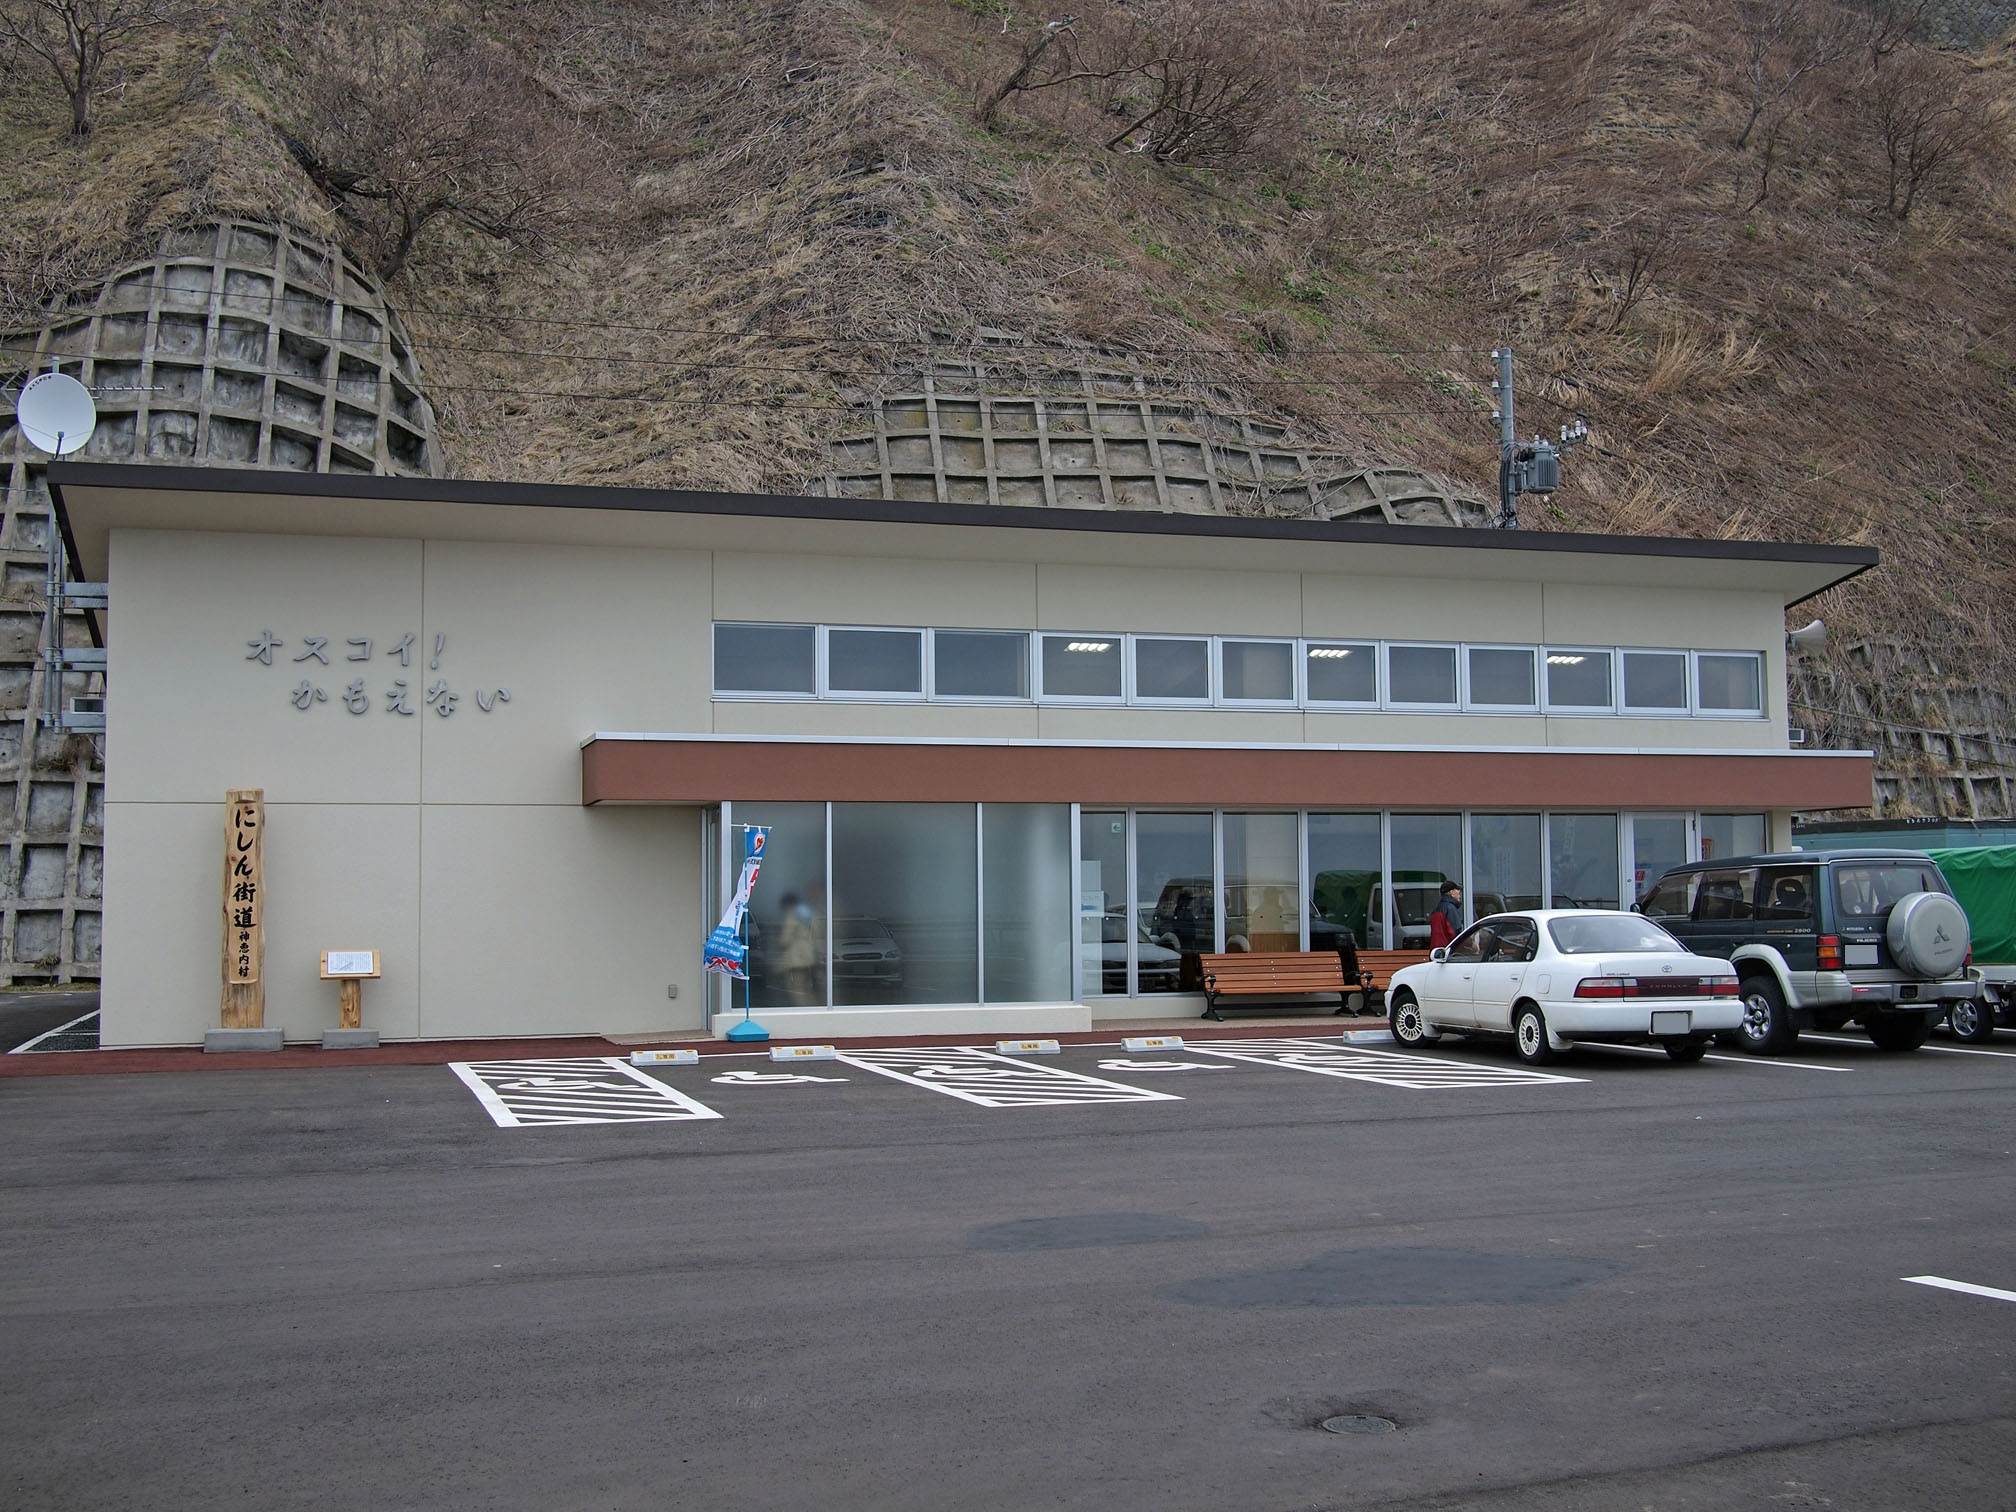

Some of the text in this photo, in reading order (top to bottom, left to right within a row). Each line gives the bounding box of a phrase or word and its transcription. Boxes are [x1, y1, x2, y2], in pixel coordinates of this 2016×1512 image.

[246, 630, 447, 670] オスコイ!
[291, 679, 511, 717] かもえない
[233, 808, 257, 929] にしん街道
[238, 930, 250, 977] 神恵内村
